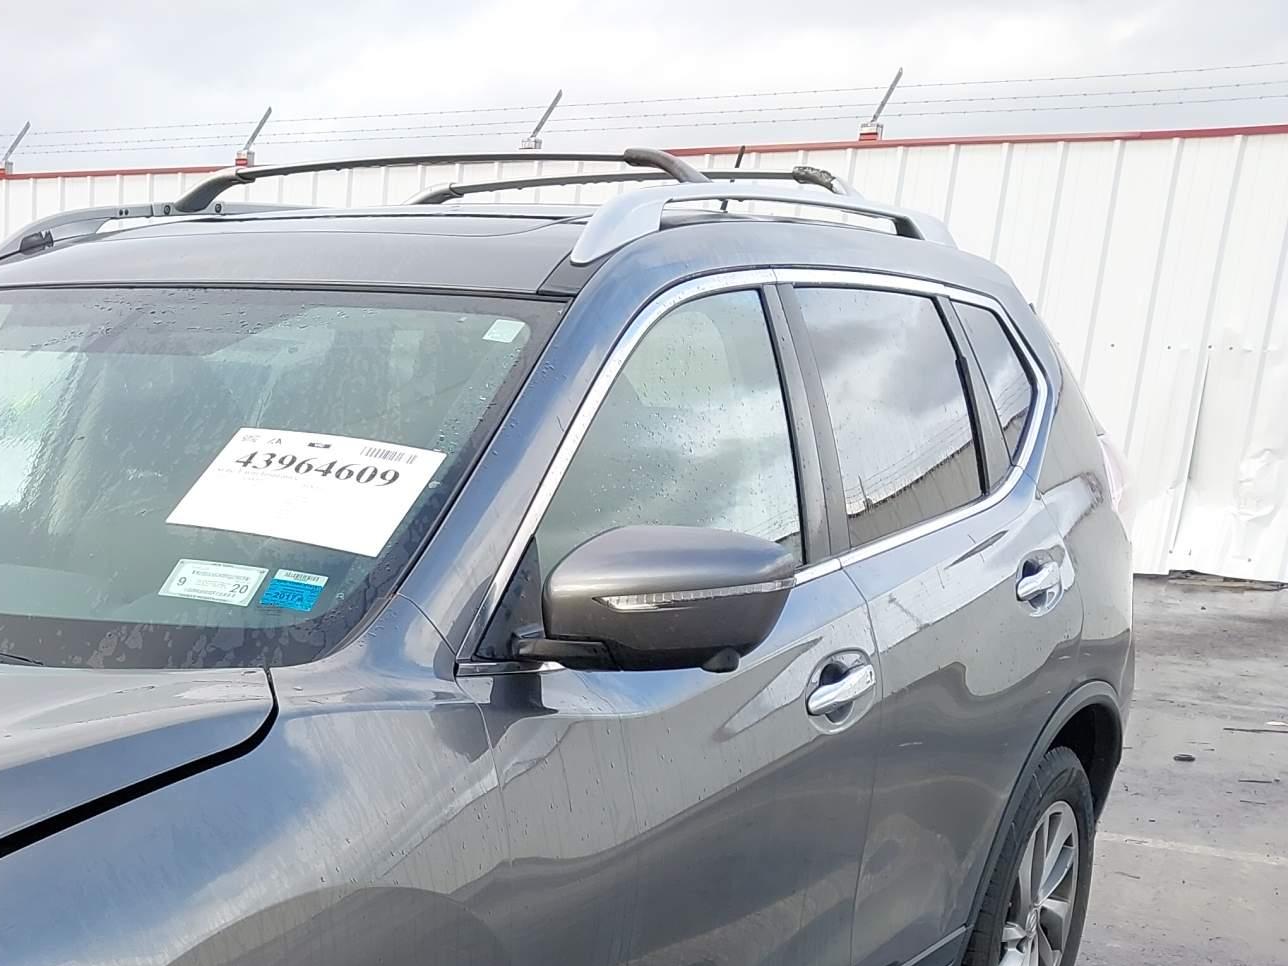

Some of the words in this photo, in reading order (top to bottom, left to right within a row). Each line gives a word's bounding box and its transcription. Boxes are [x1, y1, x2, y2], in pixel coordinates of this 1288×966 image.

[234, 450, 400, 487] 43964609
[176, 576, 188, 587] 9
[229, 583, 249, 594] 20
